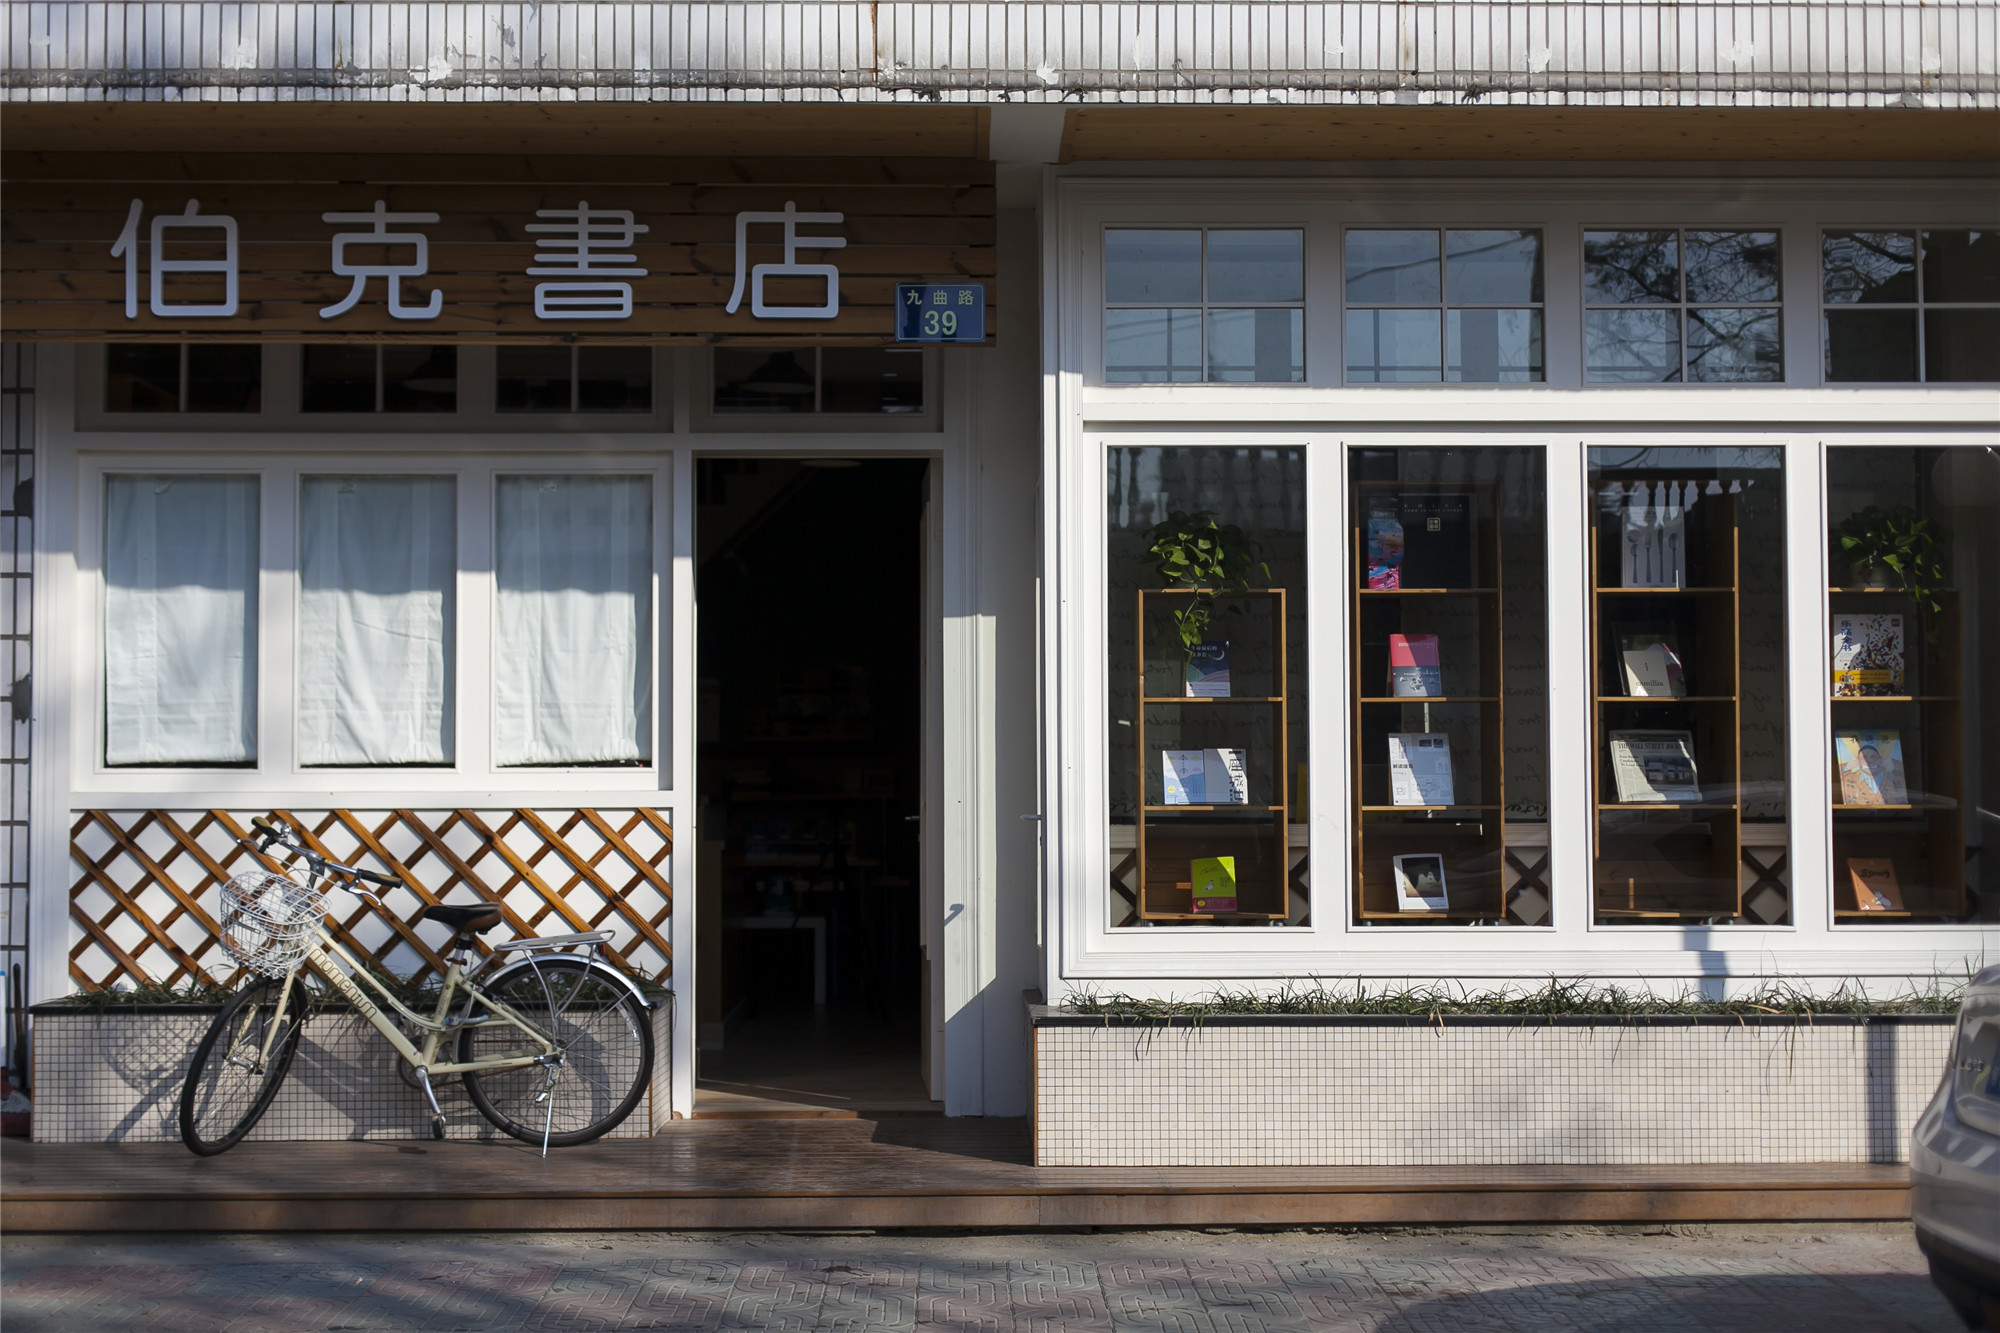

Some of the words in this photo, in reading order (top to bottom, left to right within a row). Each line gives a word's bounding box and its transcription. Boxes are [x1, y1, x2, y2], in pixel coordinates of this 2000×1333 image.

[110, 198, 848, 320] 伯克書店
[906, 289, 975, 306] 九曲路
[924, 310, 957, 336] 39
[1644, 742, 1665, 750] STREET
[308, 948, 378, 1020] momentum
